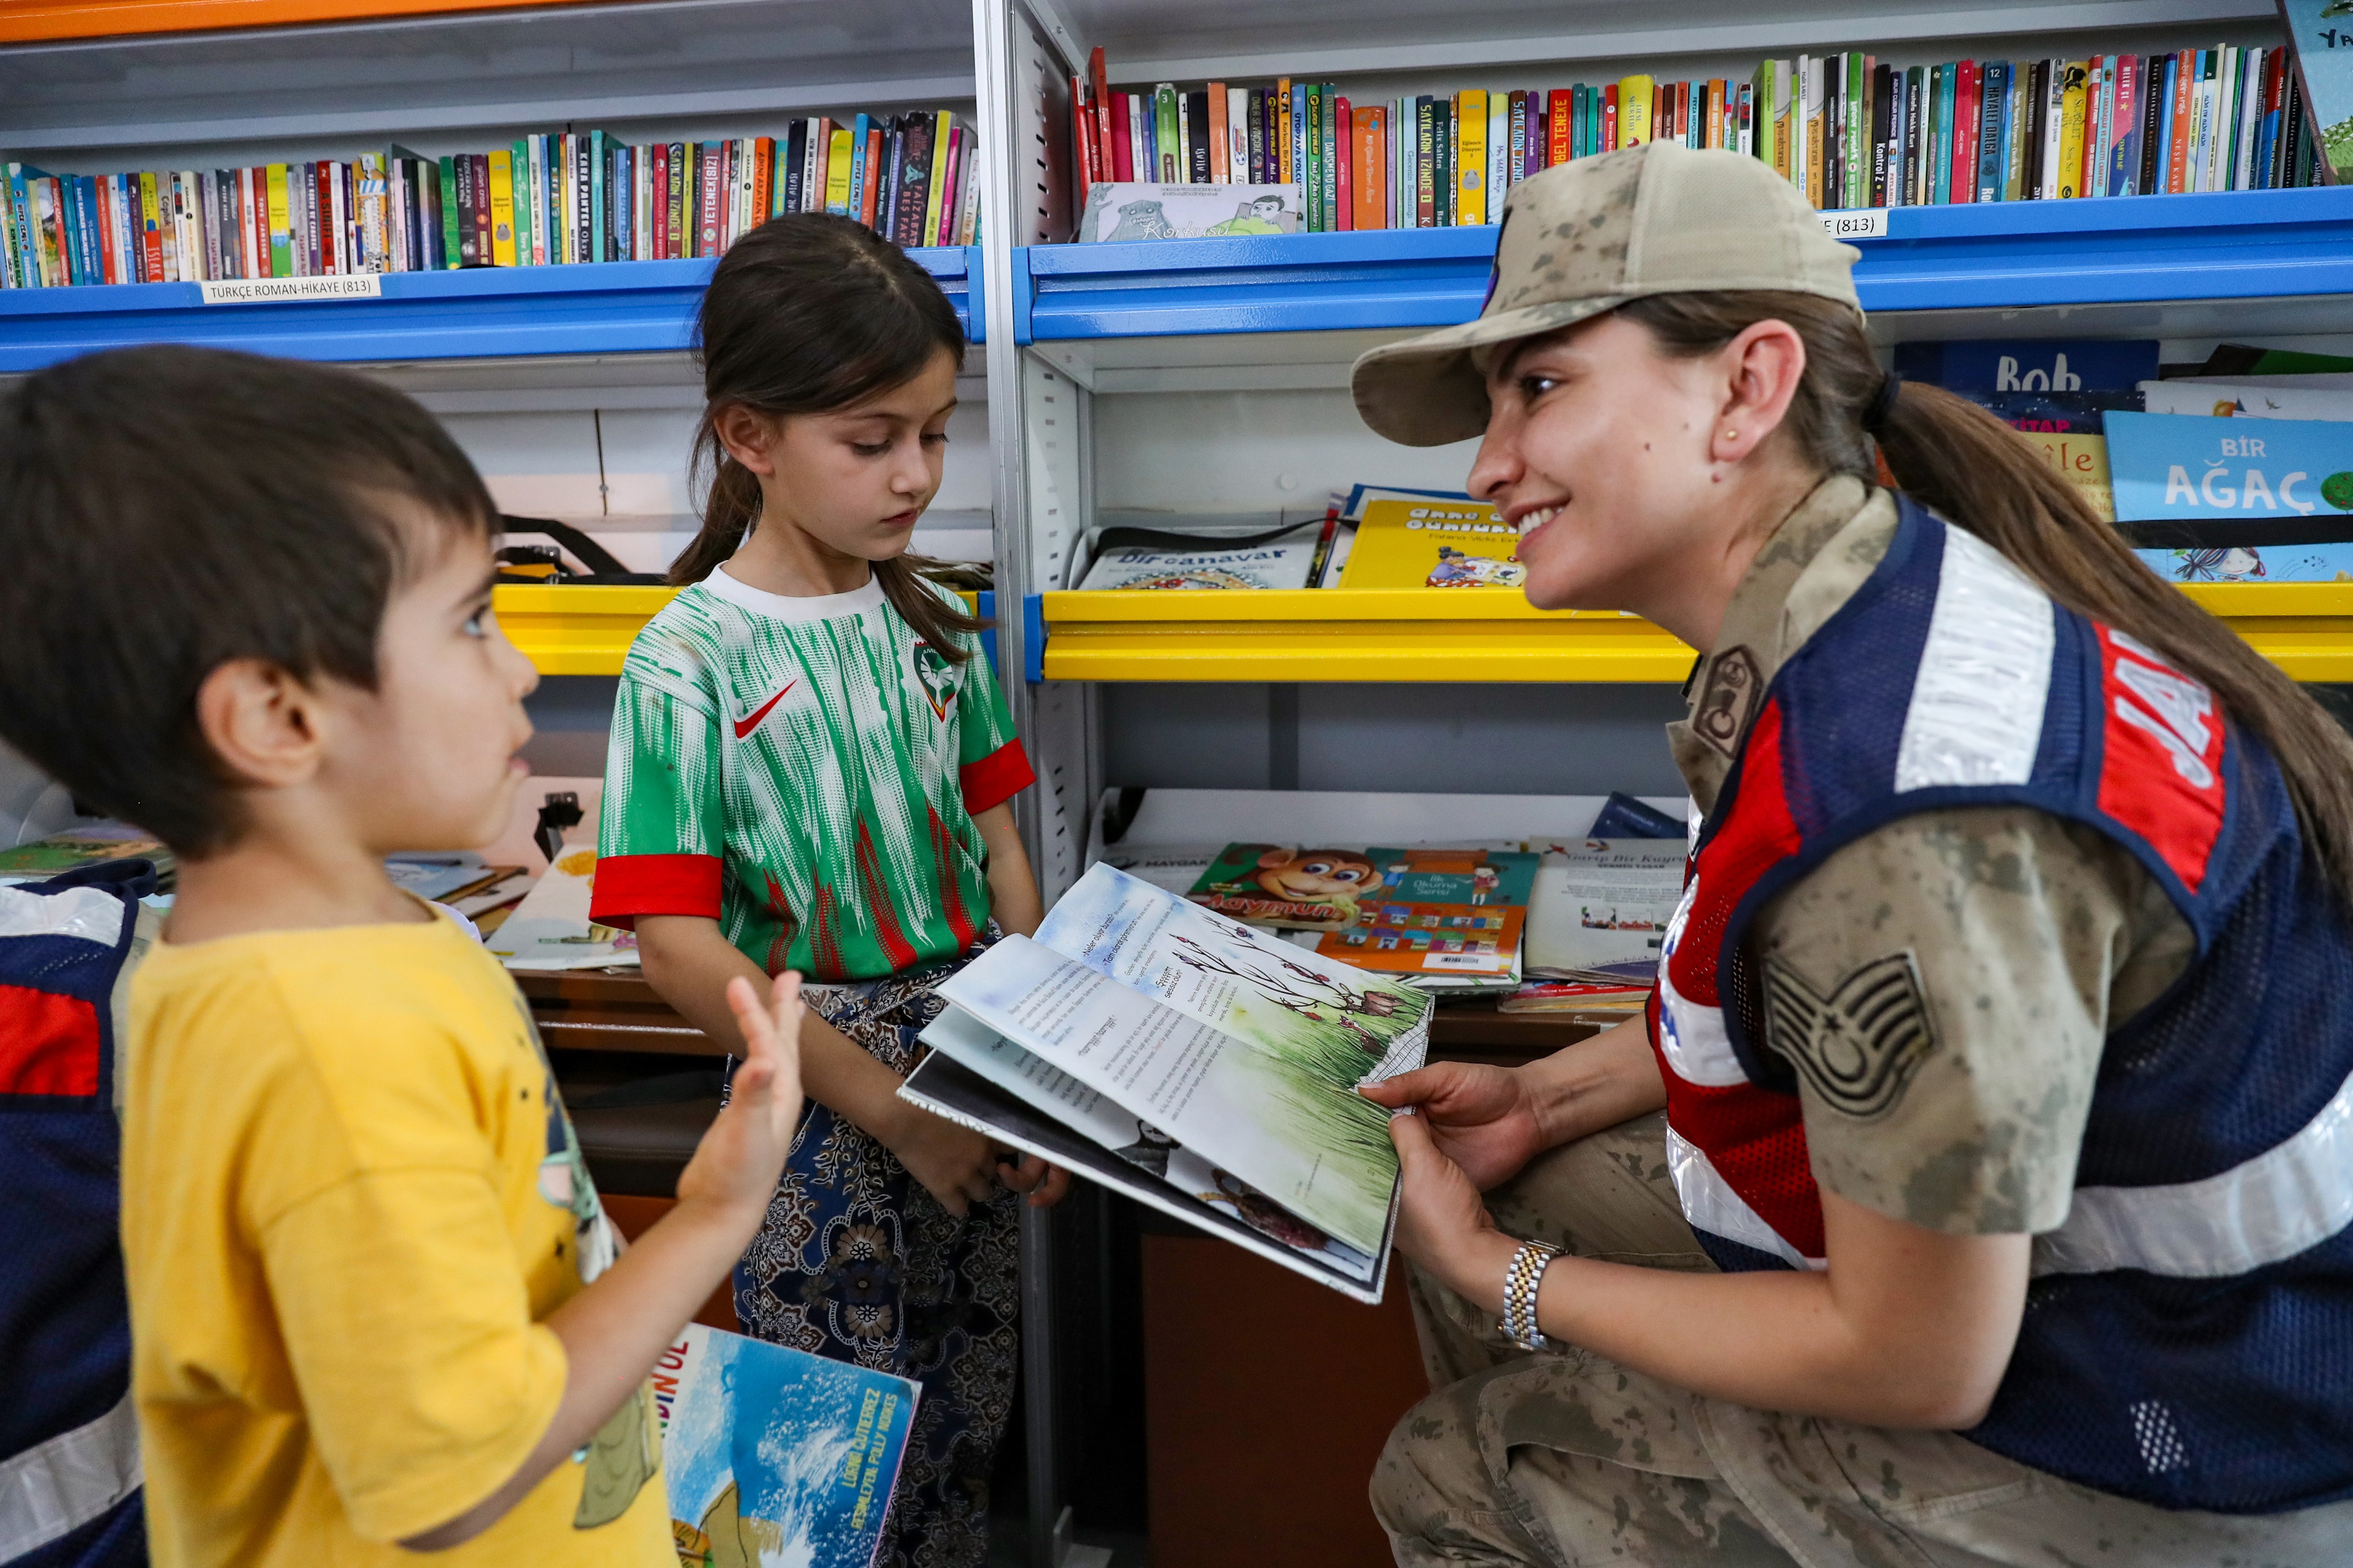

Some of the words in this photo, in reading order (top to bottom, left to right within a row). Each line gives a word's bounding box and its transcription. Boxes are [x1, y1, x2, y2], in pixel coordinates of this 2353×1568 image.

[1989, 69, 2000, 78] 12
[2121, 66, 2131, 88] MELEK
[1986, 87, 1999, 123] HAYALET
[2101, 98, 2109, 129] ARKADAŞLAR
[2149, 84, 2158, 127] Tamirhanesi
[1420, 105, 1432, 154] SAYILARIN
[1513, 101, 1525, 150] SAYILARIN
[1554, 100, 1567, 139] TENEKE
[2071, 99, 2084, 140] SCARLET
[1294, 113, 1302, 155] ÜTOPYAYA
[1984, 126, 1997, 155] DALGA
[1195, 148, 1205, 171] ATLASI
[1323, 142, 1335, 184] DANİŞMEND
[1874, 143, 1885, 174] Kontrol
[2067, 147, 2075, 159] Son
[2172, 139, 2182, 162] NEŞE
[579, 153, 588, 182] KARA
[670, 151, 681, 195] SAYILARIN
[1421, 159, 1432, 192] İZİNDE
[478, 189, 486, 208] cross
[900, 191, 911, 212] BEŞ
[1325, 184, 1335, 201] GAZİ
[581, 185, 589, 227] PANTER
[670, 200, 680, 229] İZİNDE
[1140, 220, 1230, 240] Korkusu
[1837, 217, 1874, 235] (813)
[581, 231, 589, 255] Okay
[147, 248, 162, 275] ISLAK
[211, 285, 252, 299] TÜRKÇE
[255, 281, 339, 296] ROMAN-HİKAYE
[342, 280, 371, 294] (813)
[2221, 435, 2267, 458] BİR
[2164, 458, 2316, 516] AĞAÇ
[1165, 548, 1287, 566] canavar
[1413, 880, 1458, 889] Okuma
[1417, 887, 1450, 895] Serisi
[1092, 928, 1106, 942] oluyor
[1111, 939, 1123, 952] olarak
[1162, 980, 1178, 997] sessiz
[869, 1427, 888, 1464] POLLY
